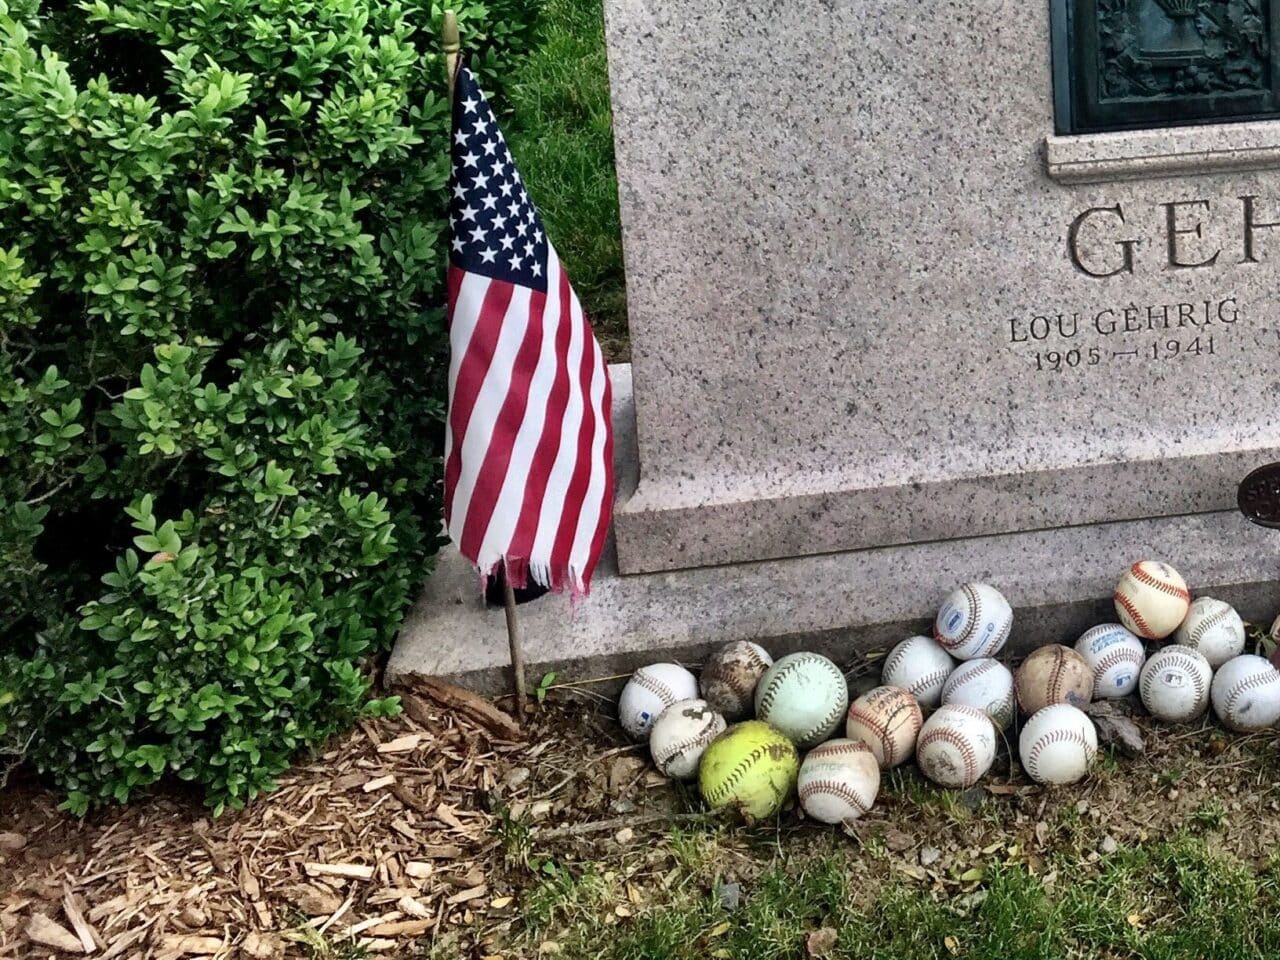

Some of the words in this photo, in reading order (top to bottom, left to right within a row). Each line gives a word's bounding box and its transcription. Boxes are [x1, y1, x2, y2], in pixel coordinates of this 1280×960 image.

[1008, 313, 1079, 343] LOU
[1095, 297, 1240, 336] GEHRIG
[1035, 348, 1101, 371] 1905
[1152, 336, 1215, 361] 1941
